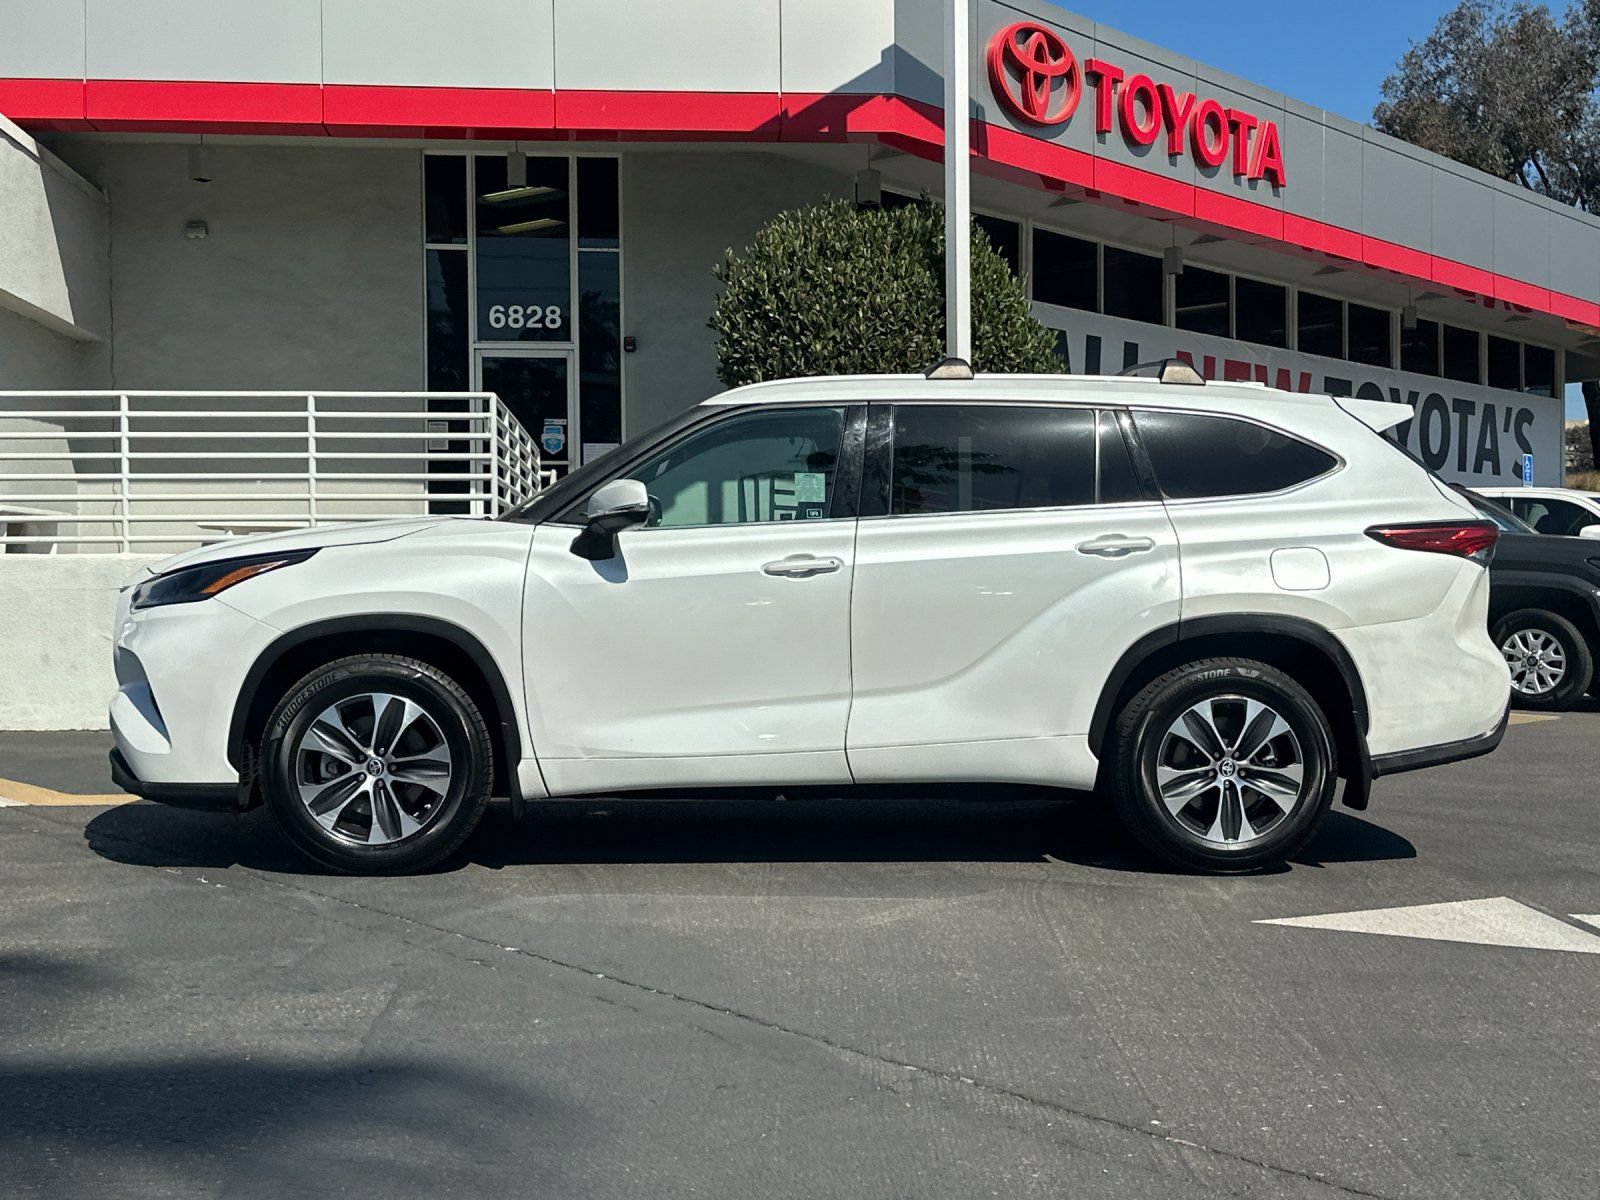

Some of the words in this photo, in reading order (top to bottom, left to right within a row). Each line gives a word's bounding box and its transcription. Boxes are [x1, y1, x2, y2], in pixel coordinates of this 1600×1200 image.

[1085, 58, 1286, 188] TOYOTA
[489, 305, 562, 329] 6828
[1324, 376, 1535, 480] YOTA'S
